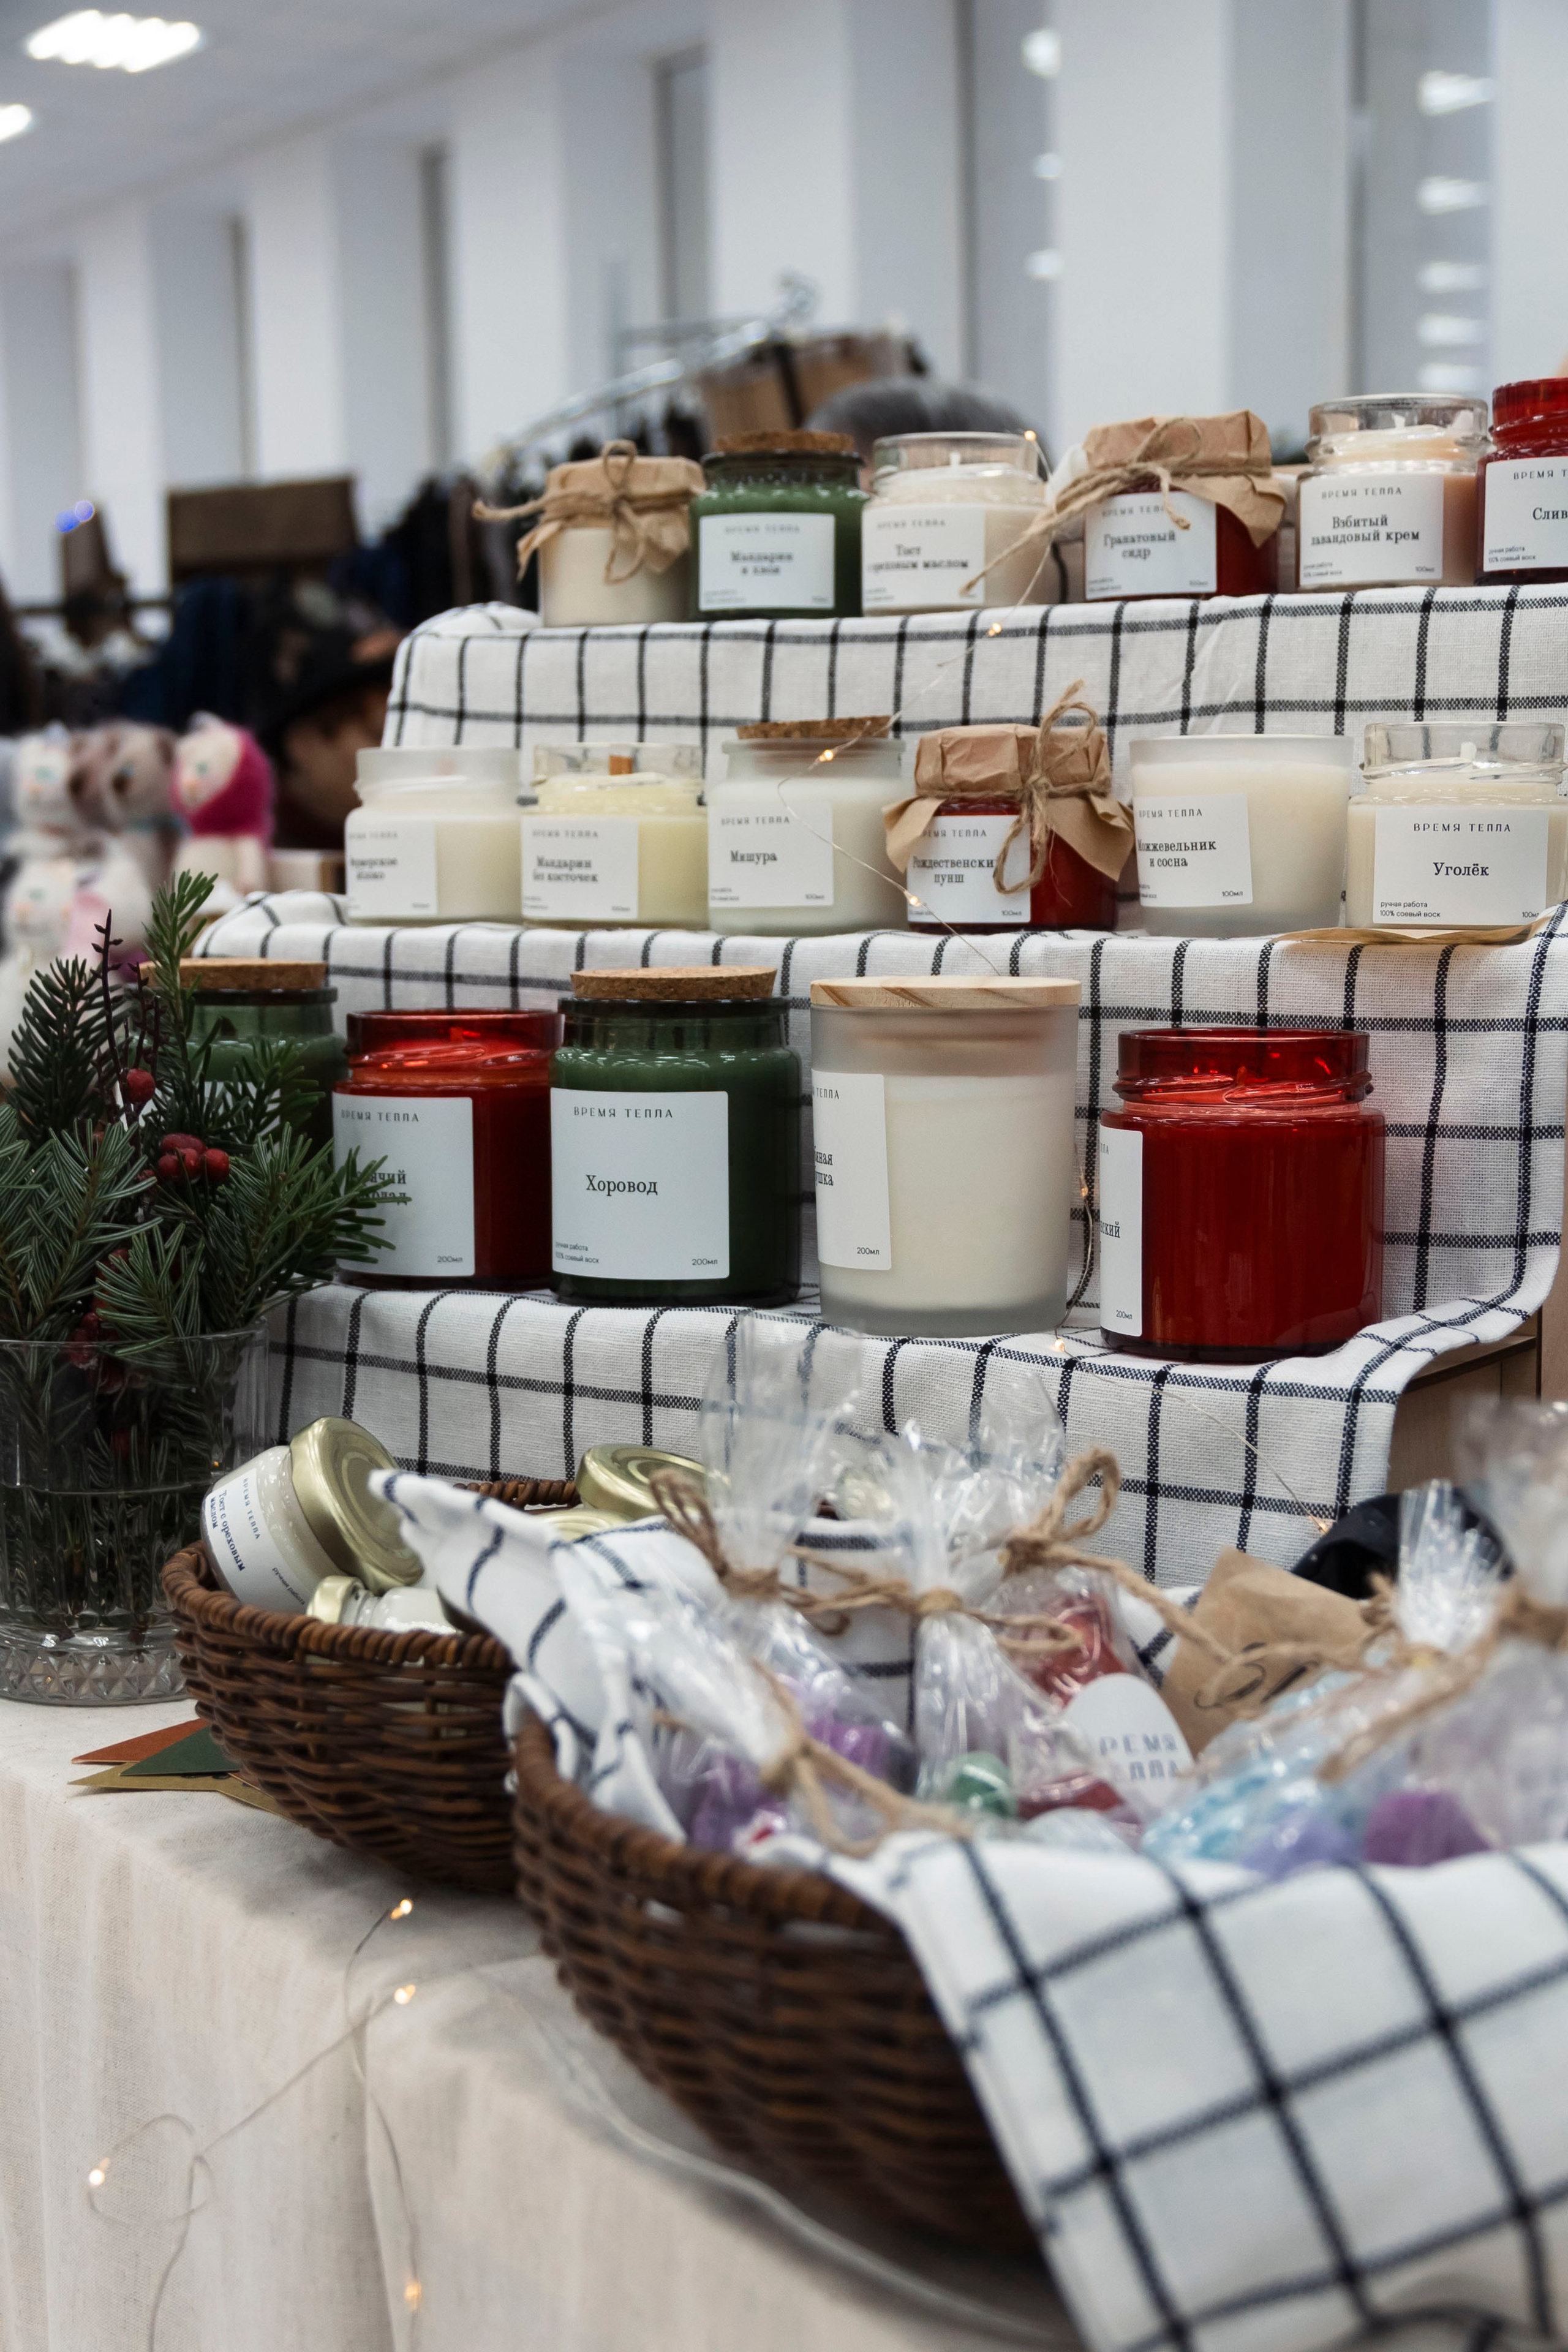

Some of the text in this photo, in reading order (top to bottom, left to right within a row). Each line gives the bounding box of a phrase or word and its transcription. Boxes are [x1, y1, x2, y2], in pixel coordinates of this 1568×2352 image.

[1513, 469, 1553, 480] ВРЕМЯ
[1364, 487, 1403, 496] ТЕПЛА
[1332, 514, 1389, 529] Взбитый
[1104, 530, 1176, 548] Гранатовый
[1385, 531, 1420, 544] крем
[1168, 809, 1202, 817] ТЕПЛА
[1414, 823, 1510, 832] ВРЕМЯ ТЕПЛА
[1137, 839, 1217, 852] Можжевельник
[730, 850, 777, 865] Мишура
[913, 856, 995, 869] Рождественски
[1150, 858, 1188, 867] и сосна
[1433, 862, 1489, 876] Уголёк
[934, 873, 964, 886] пунш
[816, 1087, 840, 1099] ТЕПЛА
[378, 1112, 419, 1121] ТЕПЛА
[574, 1107, 673, 1118] ВРЕМЯ ТЕПЛА
[586, 1175, 658, 1196] Хоровод
[1116, 1309, 1133, 1320] 200мл
[247, 1510, 260, 1539] ТЕПЛА
[221, 1520, 246, 1572] ореховым
[1100, 1733, 1177, 1755] РЕМЯ
[1129, 1759, 1178, 1780] ПЛА
